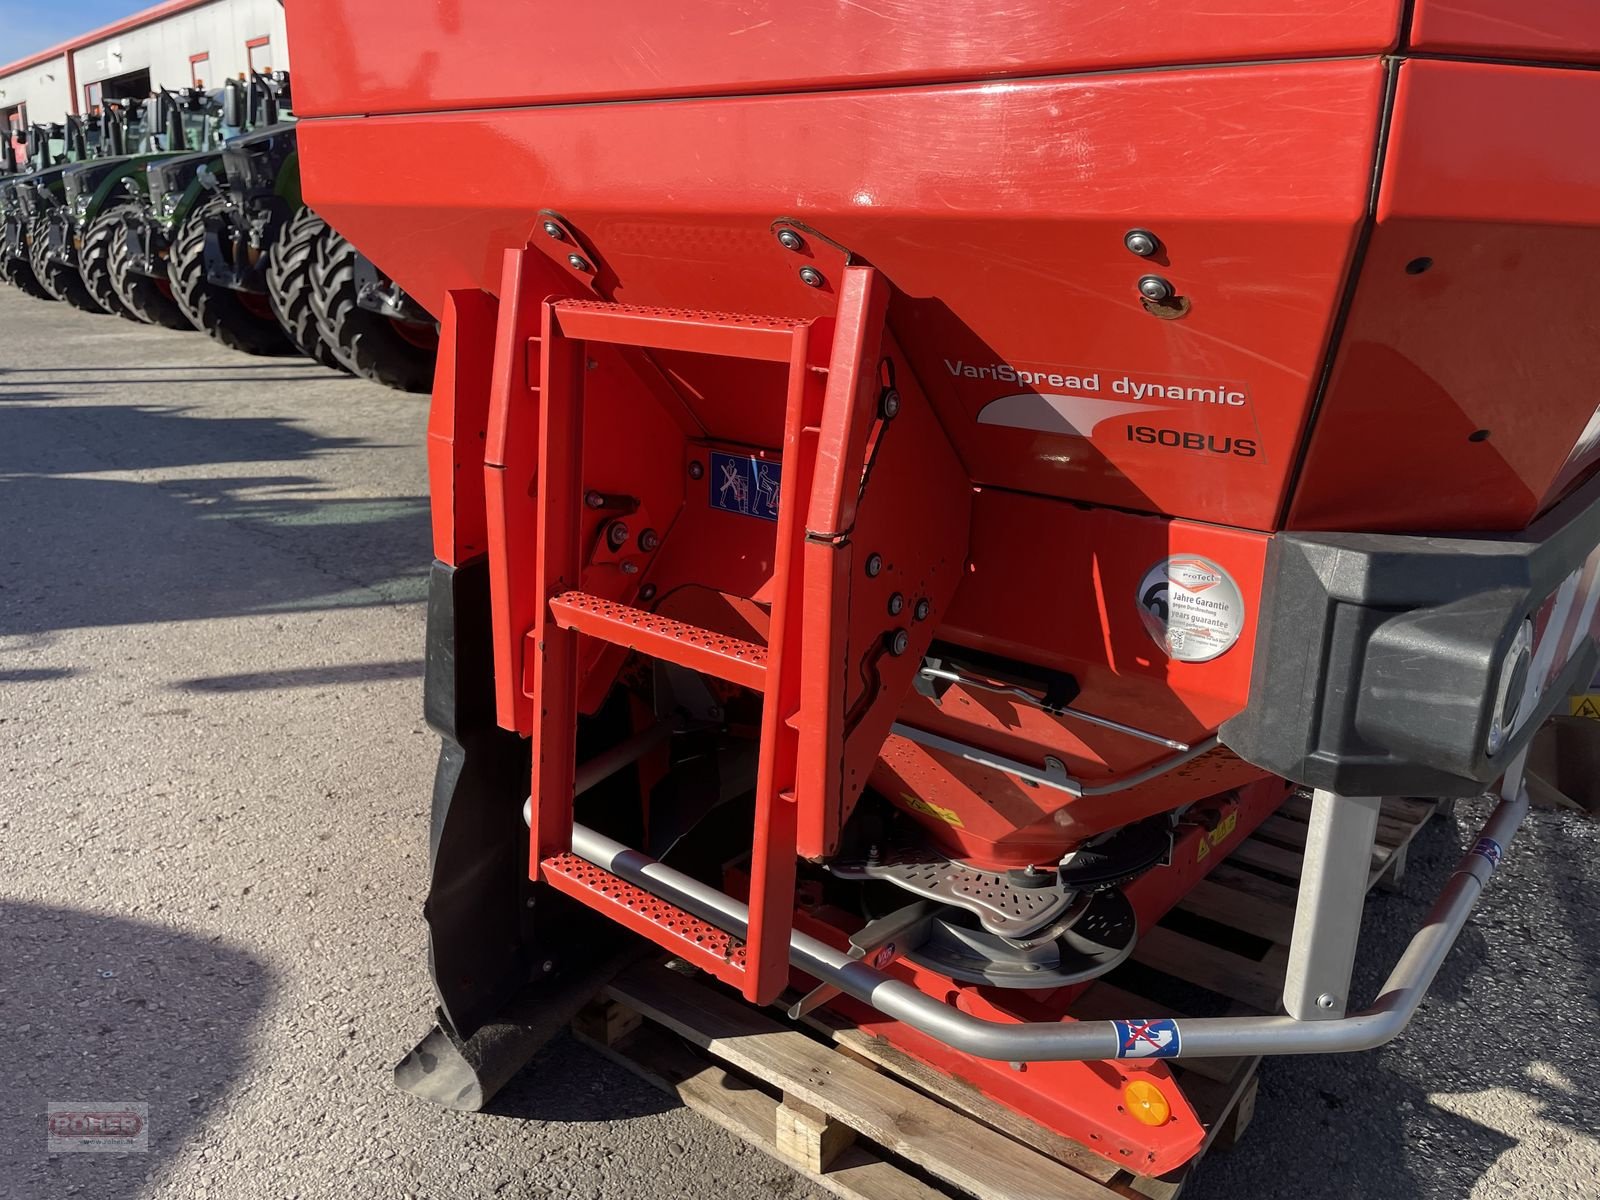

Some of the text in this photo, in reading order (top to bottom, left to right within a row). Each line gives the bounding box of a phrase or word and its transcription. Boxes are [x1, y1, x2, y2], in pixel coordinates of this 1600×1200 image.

[944, 358, 1246, 406] VariSpread dynamic
[1127, 424, 1257, 457] ISOBUS
[1173, 591, 1230, 611] Jahre Garantie
[1171, 610, 1190, 620] years
[1191, 614, 1229, 629] guarantee
